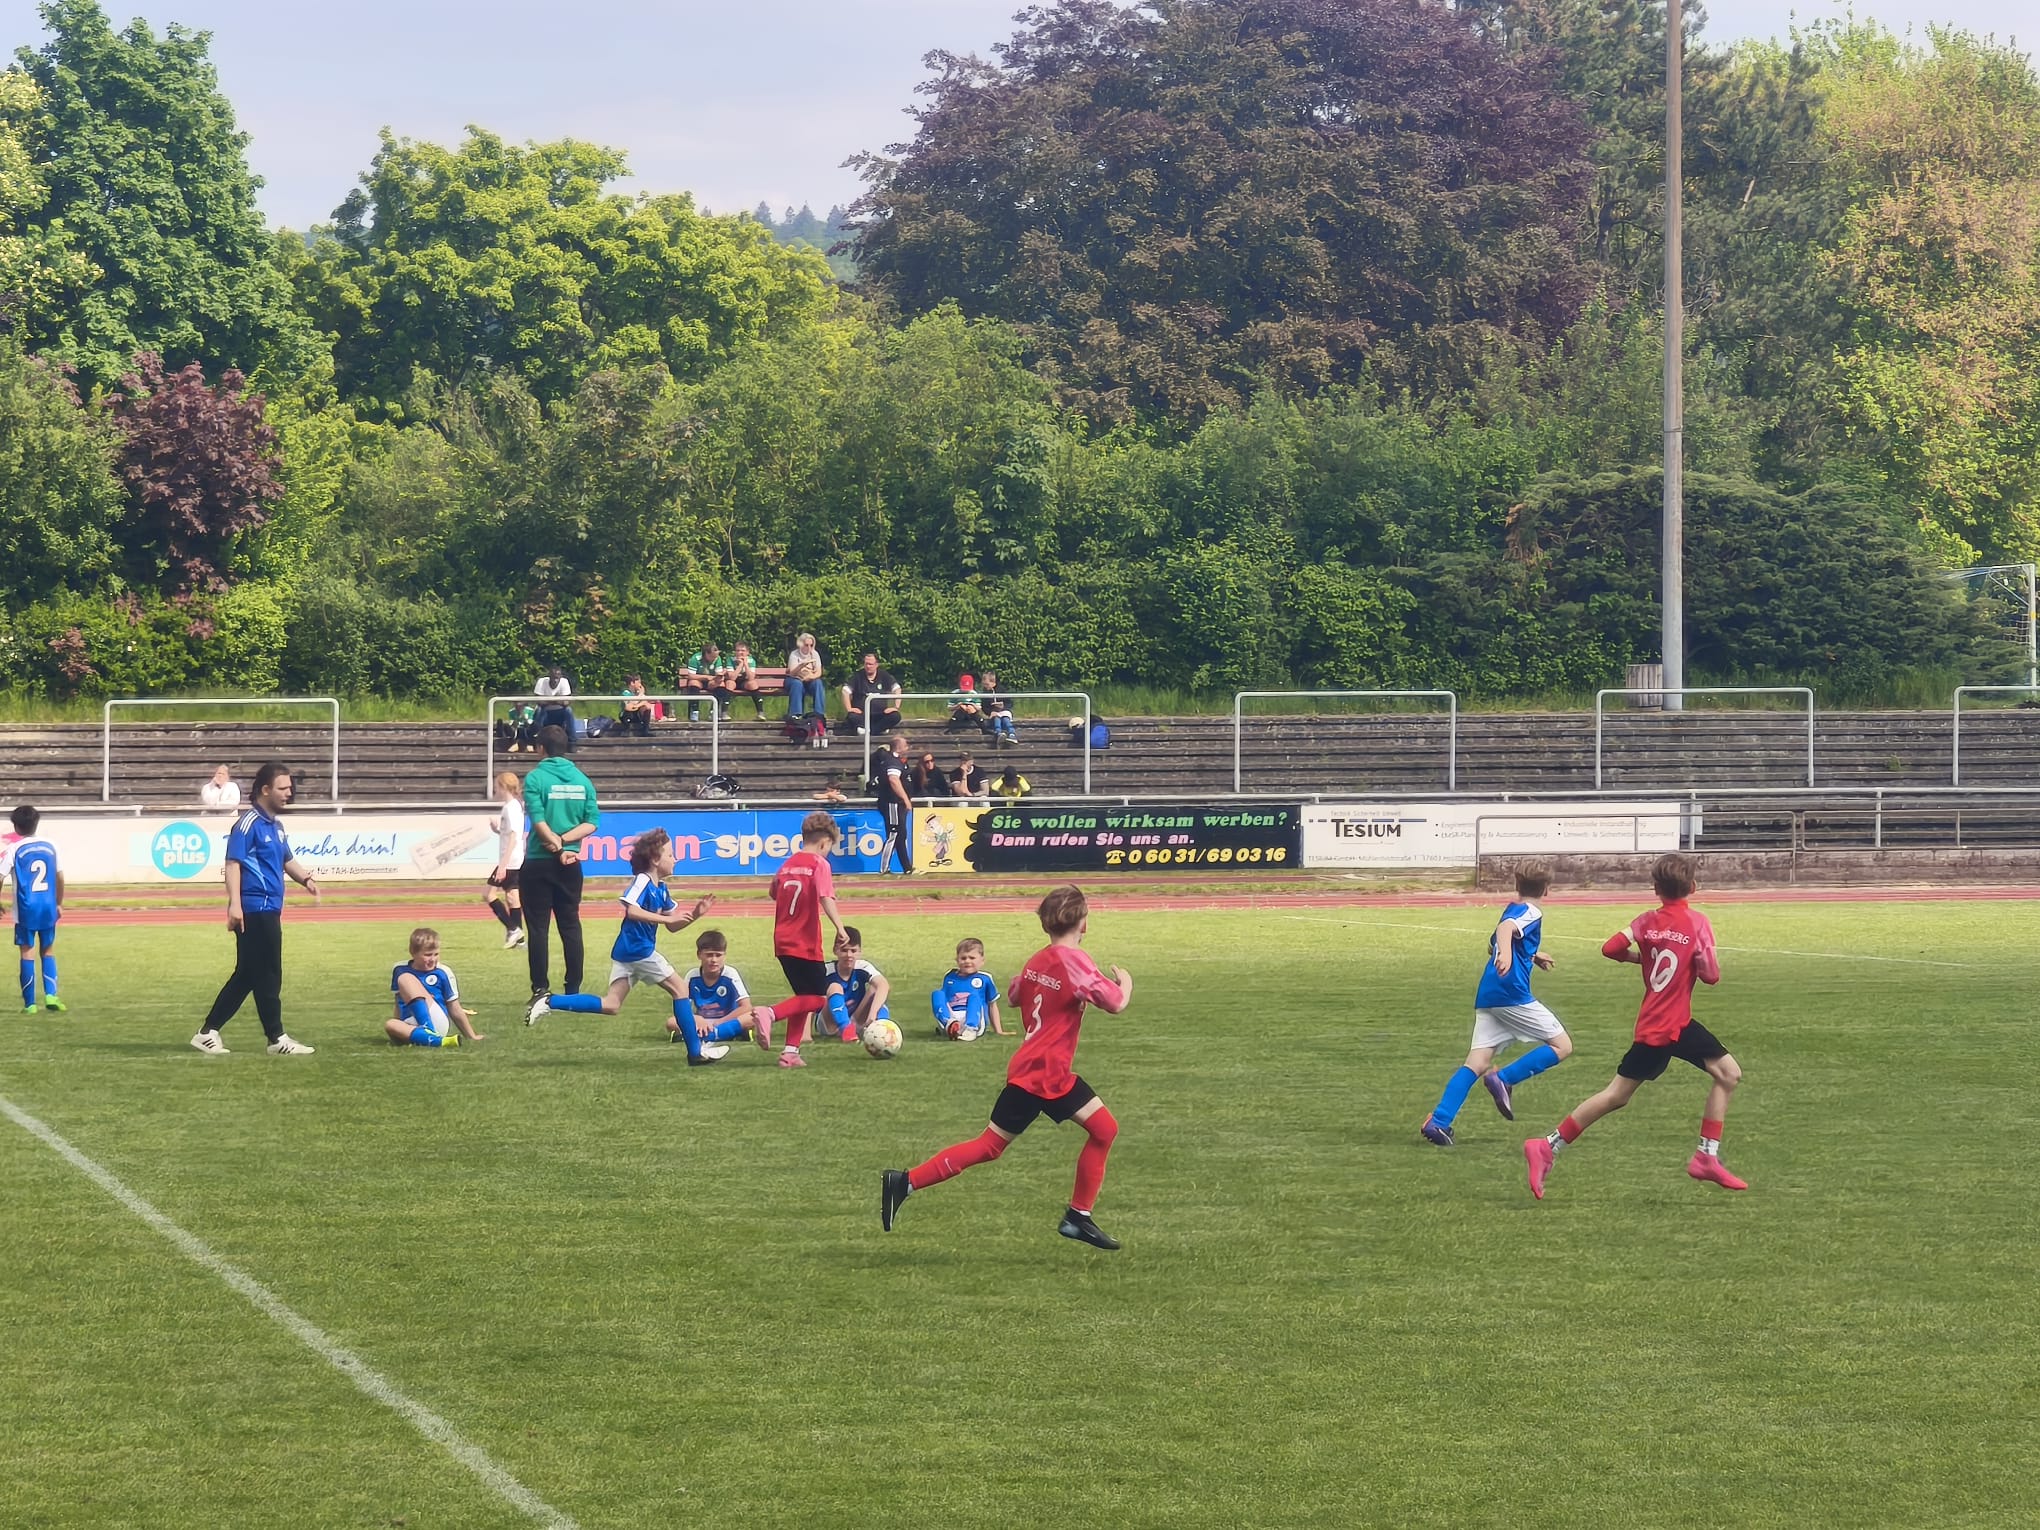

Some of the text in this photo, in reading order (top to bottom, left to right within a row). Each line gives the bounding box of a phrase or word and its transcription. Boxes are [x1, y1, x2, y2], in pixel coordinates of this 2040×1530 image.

[991, 815, 1022, 829] Sie
[1030, 814, 1097, 829] wollen
[1105, 813, 1194, 828] wirksam
[155, 833, 203, 851] ABO
[294, 834, 340, 856] mehr
[346, 833, 397, 856] drin!
[580, 835, 700, 861] man
[991, 833, 1195, 847] Dann rufen Sie uns an.
[163, 849, 206, 868] plus
[1128, 849, 1142, 864] 0
[1145, 849, 1172, 864] 60
[1235, 848, 1262, 862] 03
[1265, 847, 1287, 862] 16
[31, 859, 49, 892] 2
[783, 880, 802, 915] 7
[1024, 993, 1043, 1041] 3
